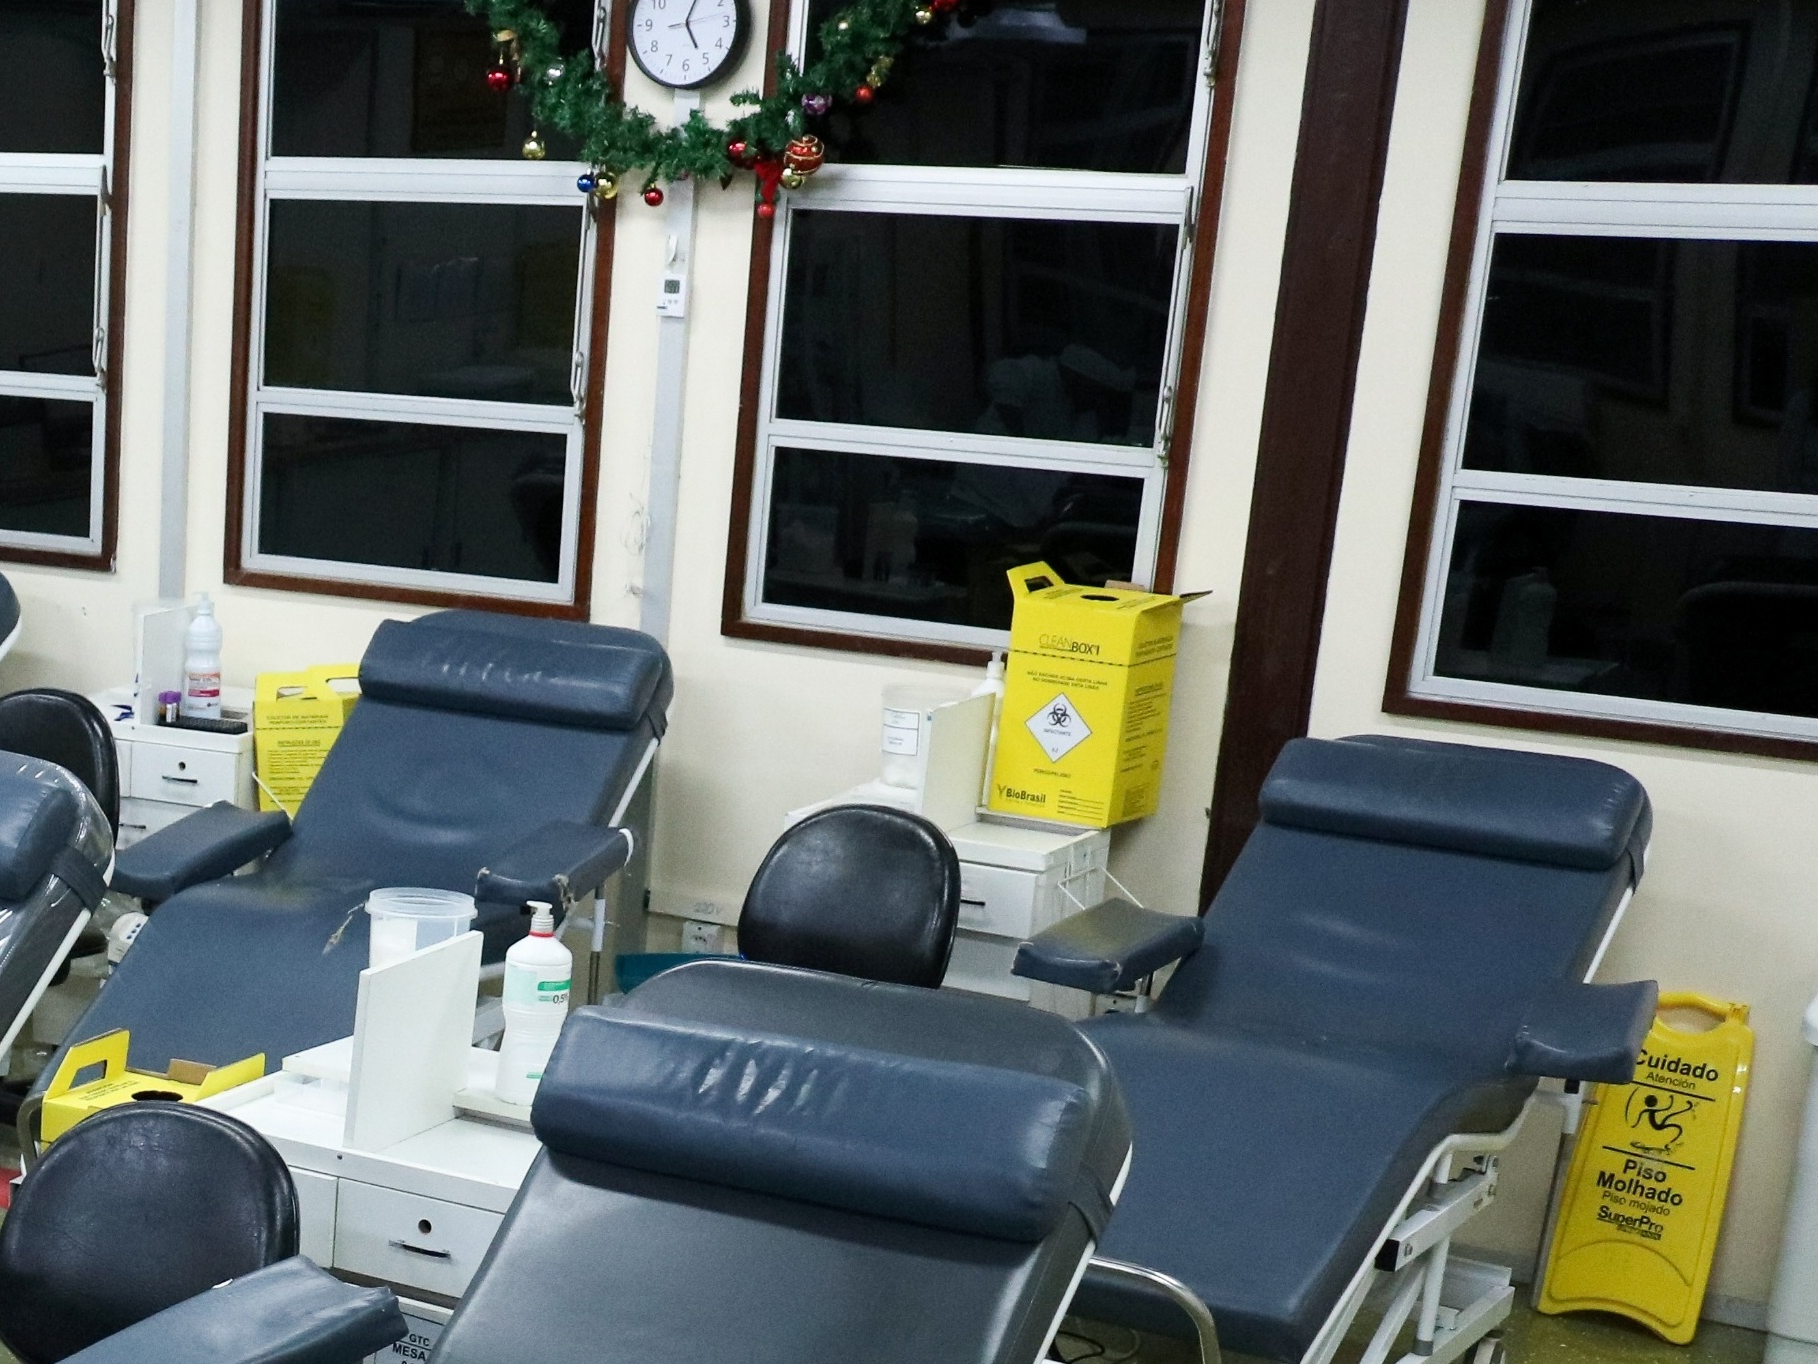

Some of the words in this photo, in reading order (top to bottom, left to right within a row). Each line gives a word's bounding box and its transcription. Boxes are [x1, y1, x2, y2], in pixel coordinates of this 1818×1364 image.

[652, 0, 666, 9] 10
[645, 19, 653, 31] 9
[723, 15, 730, 28] 3
[650, 40, 659, 52] 8
[715, 37, 723, 49] 4
[666, 54, 673, 66] 7
[682, 59, 690, 71] 6
[702, 52, 709, 65] 5
[1006, 788, 1046, 803] BioBrasil
[1646, 1071, 1696, 1090] Atención
[1623, 1158, 1667, 1183] Piso
[1596, 1170, 1683, 1206] Molhado
[1602, 1190, 1626, 1205] Piso
[1628, 1199, 1670, 1216] mojado
[1597, 1204, 1664, 1232] SuperPro
[408, 1333, 430, 1347] GTC
[392, 1341, 426, 1361] MESA
